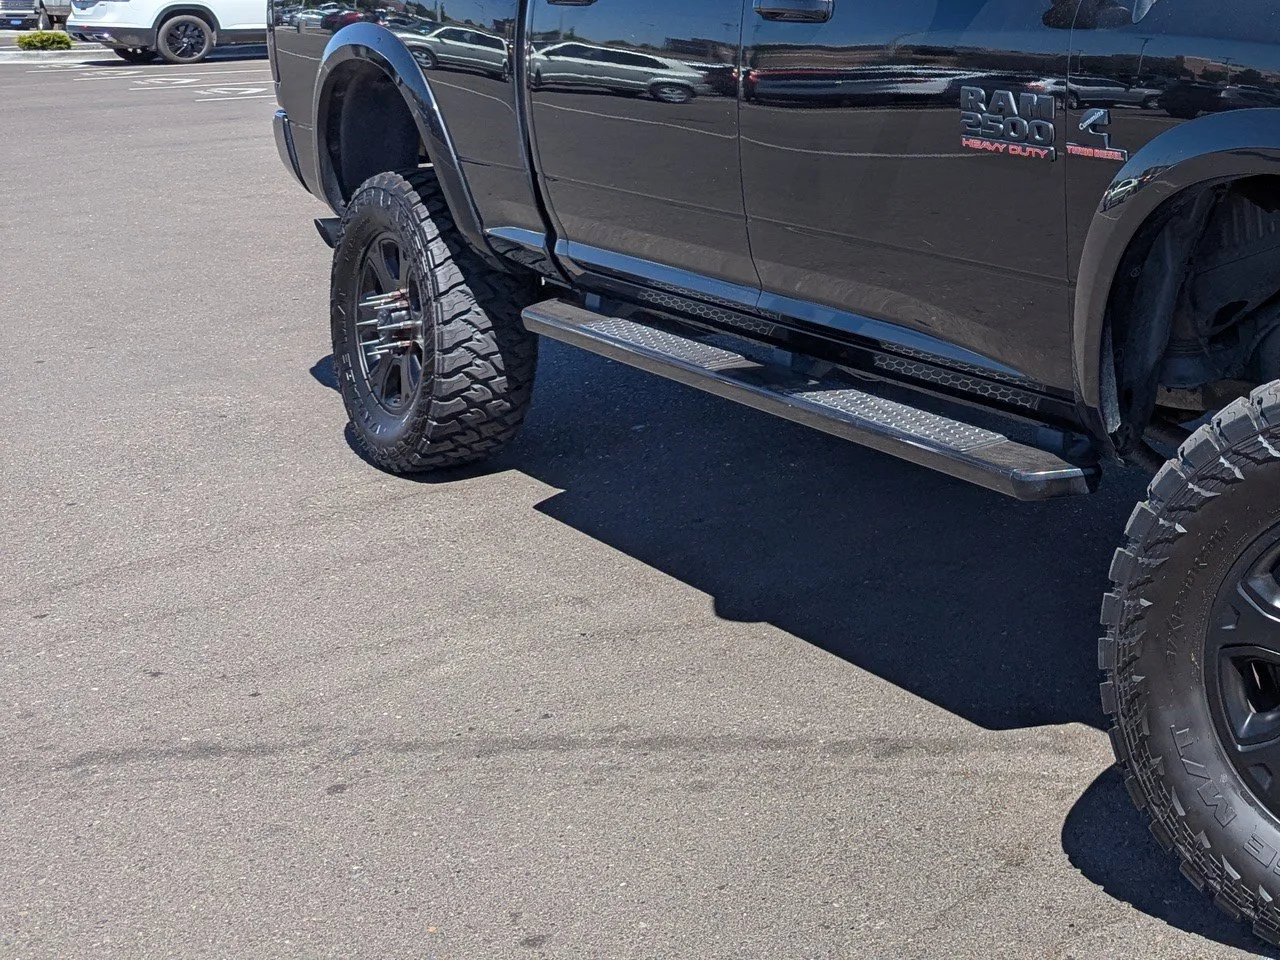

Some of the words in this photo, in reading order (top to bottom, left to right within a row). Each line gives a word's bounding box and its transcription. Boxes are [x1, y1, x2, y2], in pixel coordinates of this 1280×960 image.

[960, 86, 1055, 119] RAM
[960, 111, 1055, 143] 2500
[962, 137, 1007, 153] HEAVY
[1009, 144, 1049, 159] DUTY
